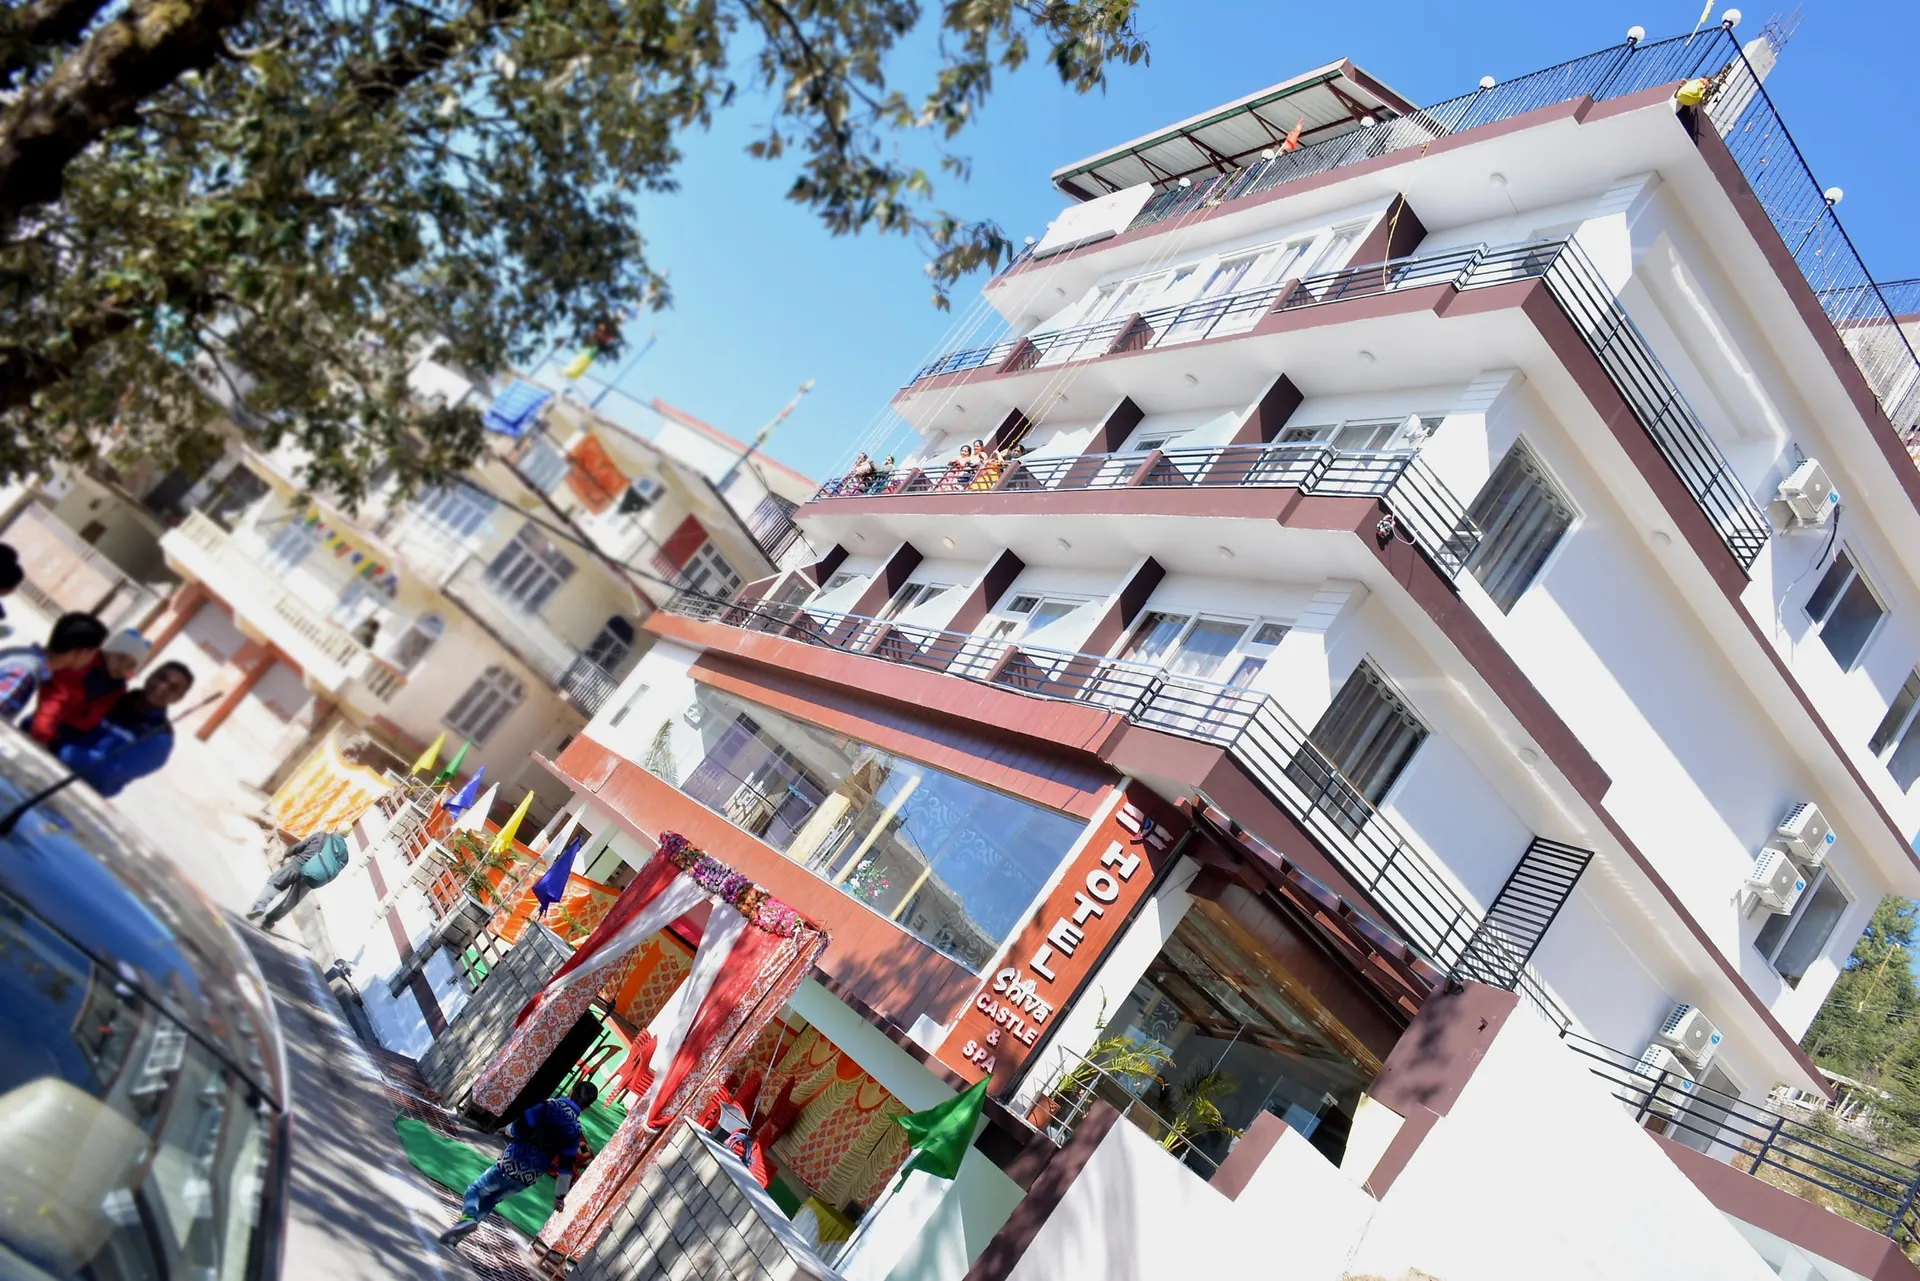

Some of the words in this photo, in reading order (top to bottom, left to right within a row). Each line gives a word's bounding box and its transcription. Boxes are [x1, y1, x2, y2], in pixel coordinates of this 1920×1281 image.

[1029, 840, 1141, 982] HOTEL
[976, 992, 1038, 1048] CASTLE
[992, 967, 1053, 1024] Shiva
[962, 1039, 996, 1073] SPA
[986, 1028, 1000, 1046] &
